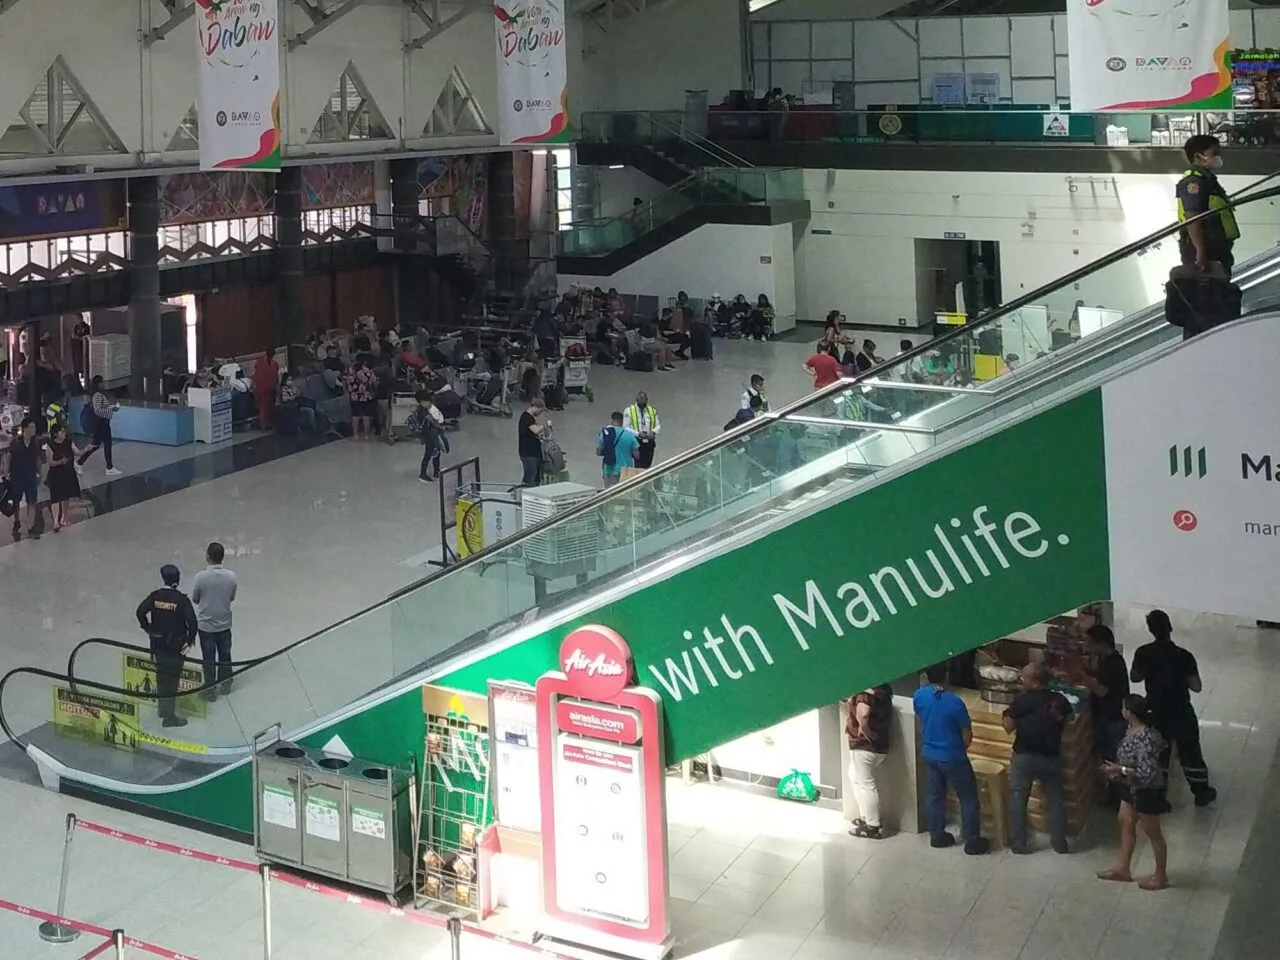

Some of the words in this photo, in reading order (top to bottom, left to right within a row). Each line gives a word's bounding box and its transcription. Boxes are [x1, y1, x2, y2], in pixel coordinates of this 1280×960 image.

[205, 16, 276, 56] Dabaw
[648, 613, 774, 701] with
[773, 504, 1069, 651] Manulife.
[569, 711, 624, 730] airasia.com
